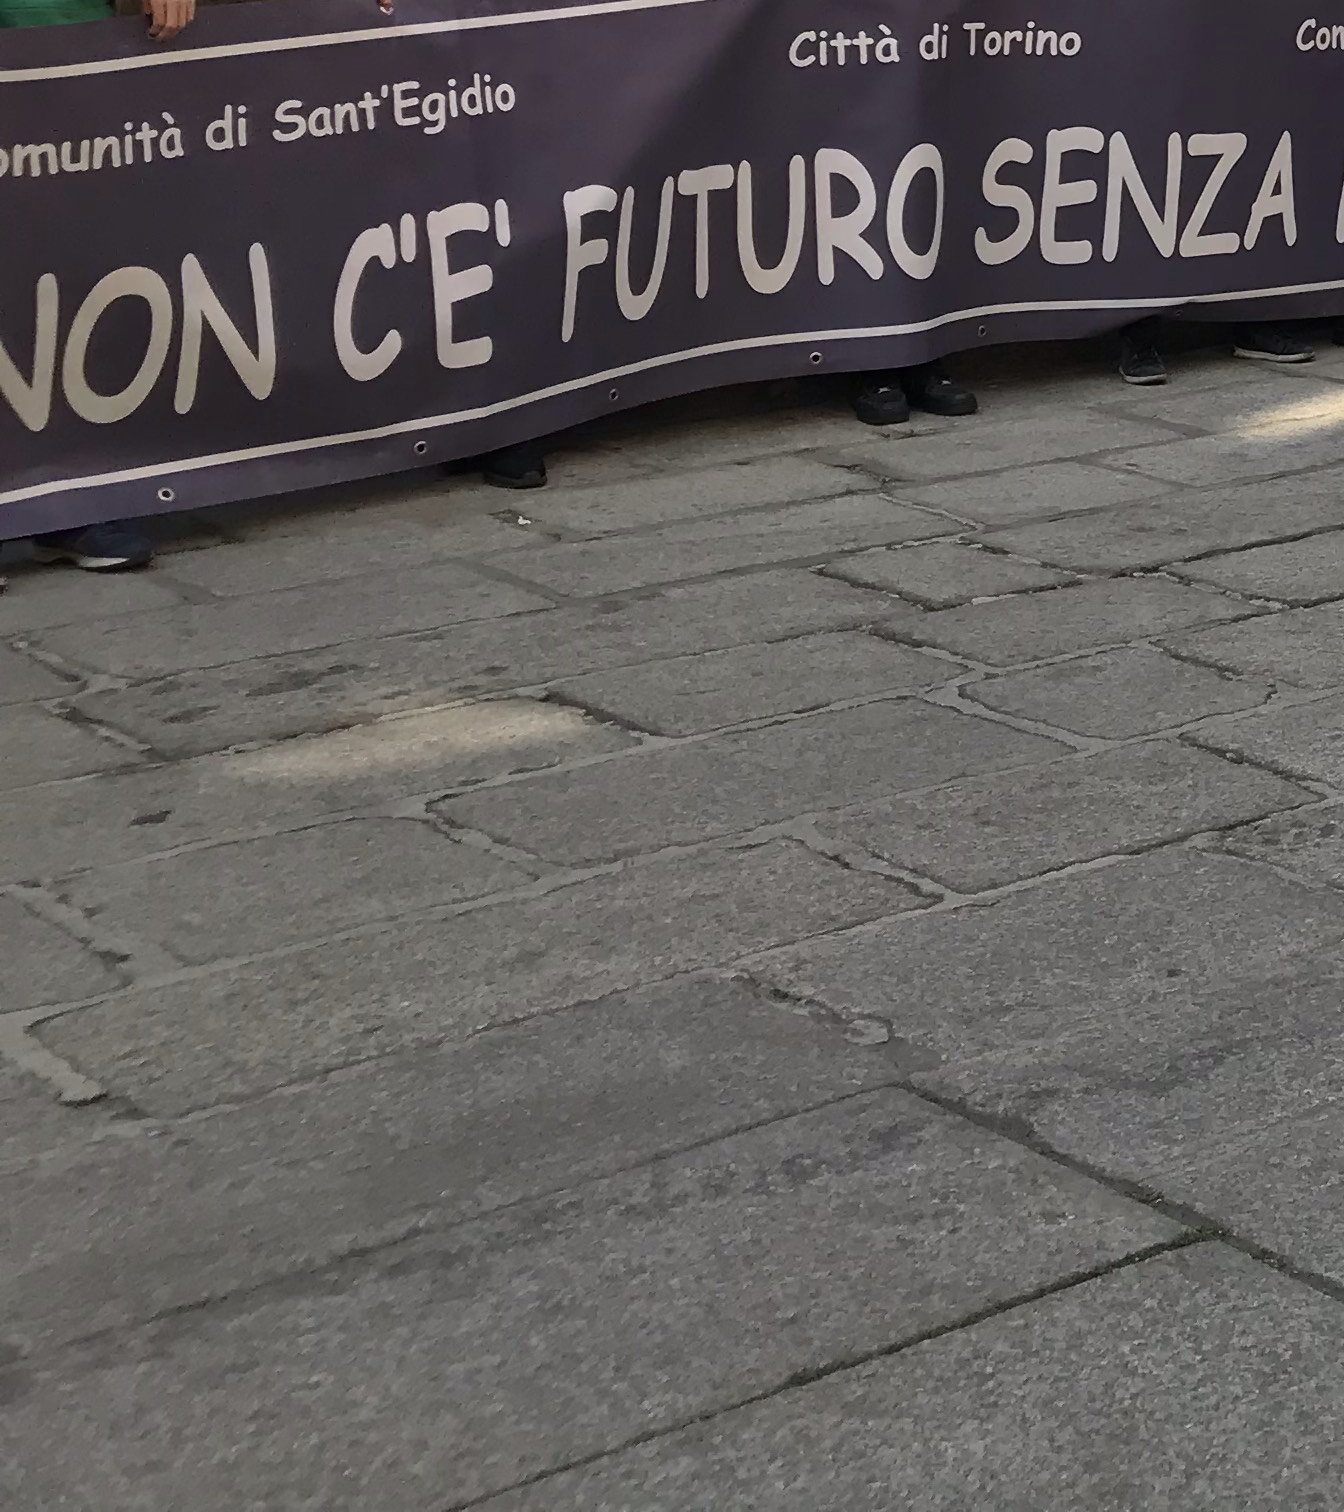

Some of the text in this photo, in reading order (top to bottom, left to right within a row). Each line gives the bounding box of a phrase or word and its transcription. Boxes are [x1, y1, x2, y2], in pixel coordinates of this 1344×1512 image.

[788, 20, 1083, 68] Città di Torino
[0, 73, 517, 178] munità di Sant'Egidio
[0, 241, 277, 433] NON
[561, 143, 945, 344] FUTURO
[974, 126, 1298, 266] SENZA
